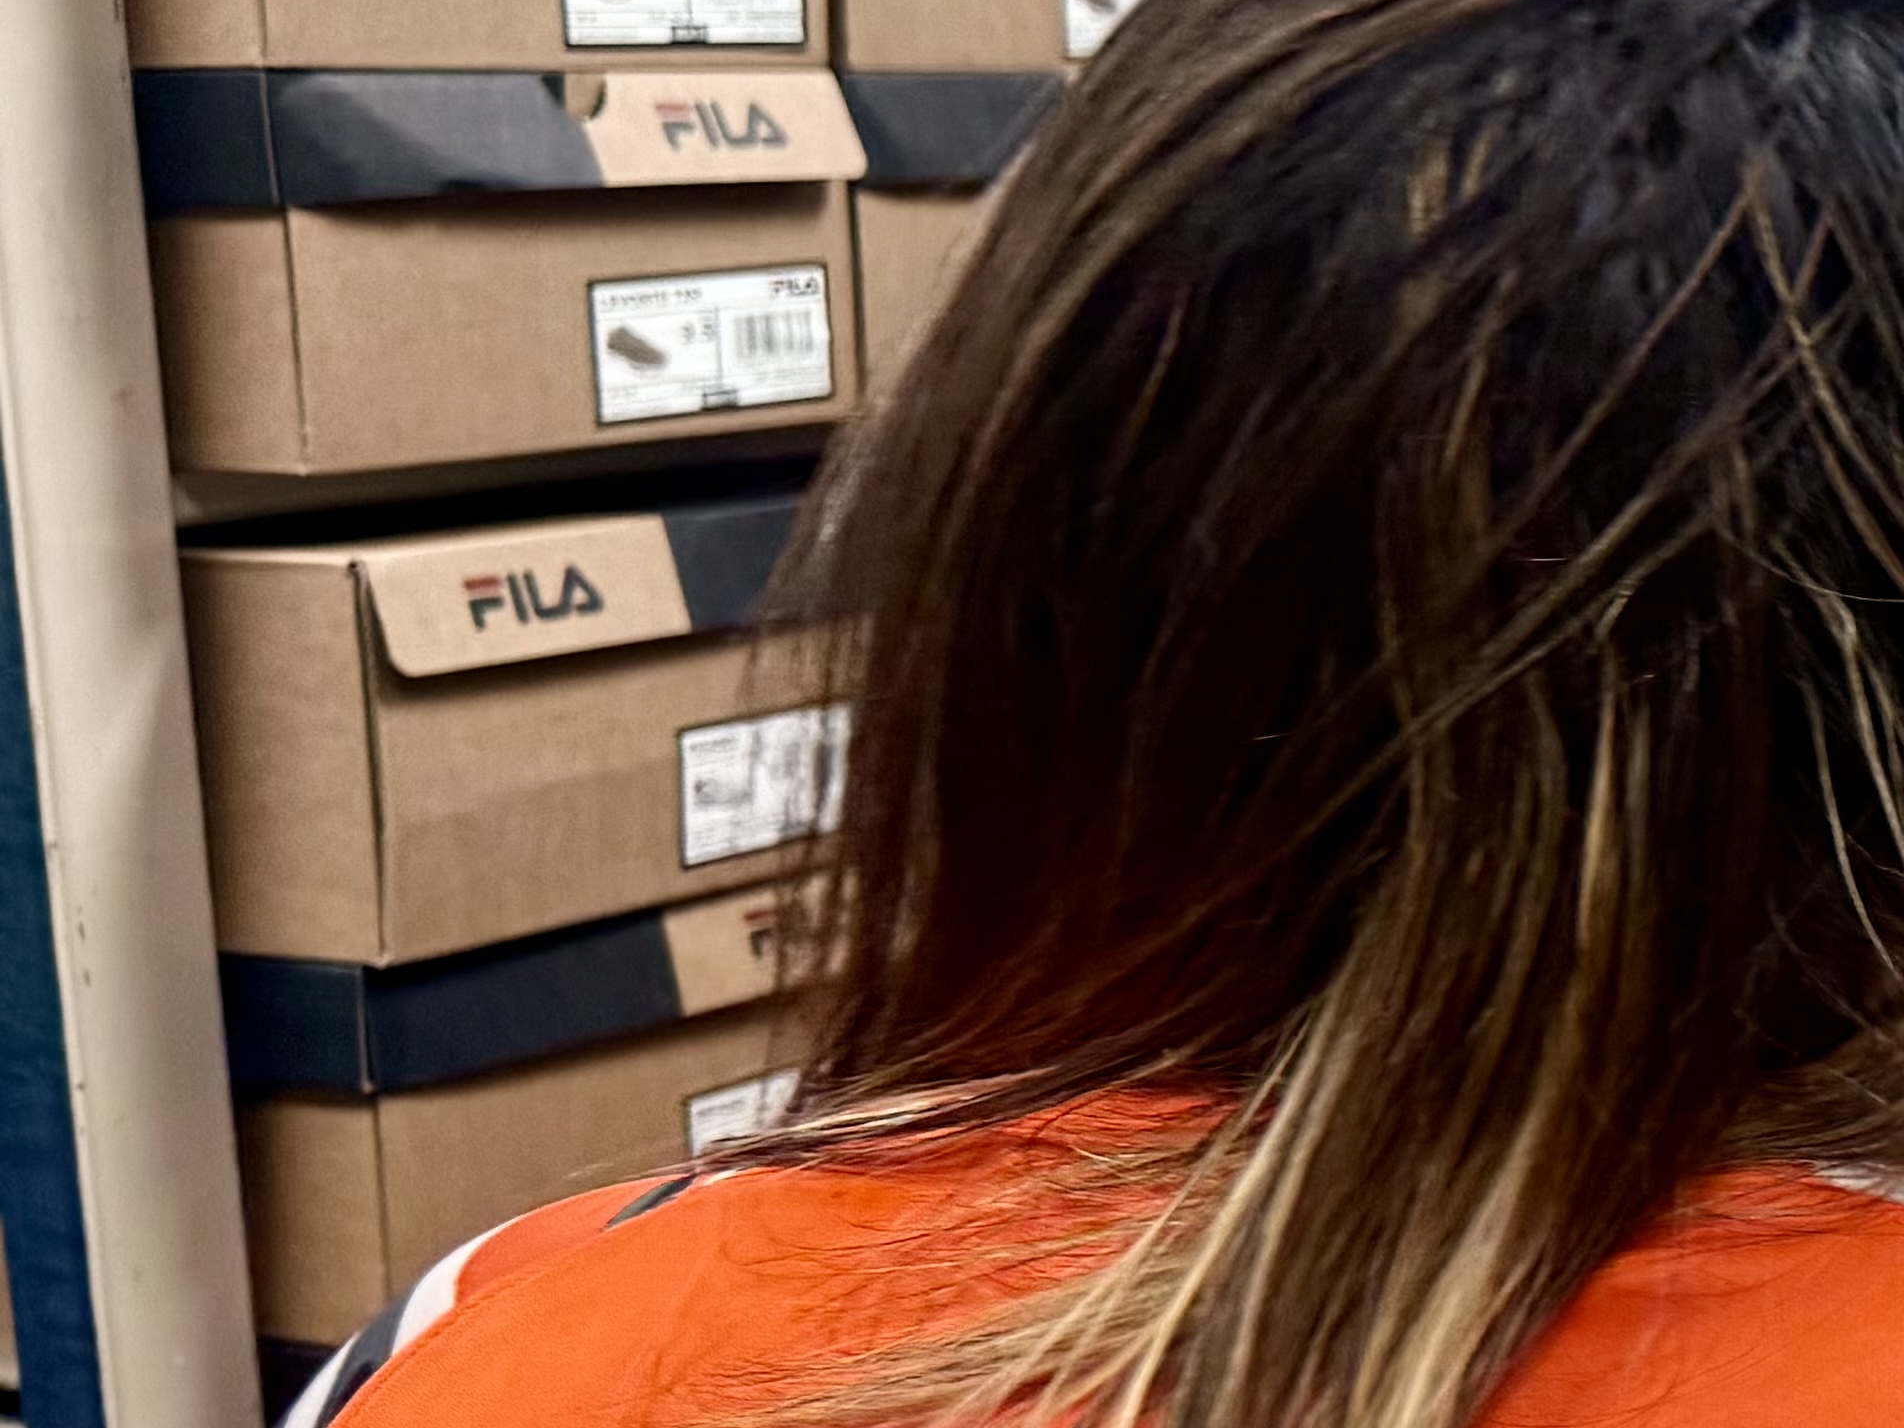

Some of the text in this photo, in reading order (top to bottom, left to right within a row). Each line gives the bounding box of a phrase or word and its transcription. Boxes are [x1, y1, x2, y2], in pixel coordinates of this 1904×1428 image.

[655, 99, 789, 152] FILA
[770, 275, 820, 299] FILA
[464, 565, 604, 632] FILA
